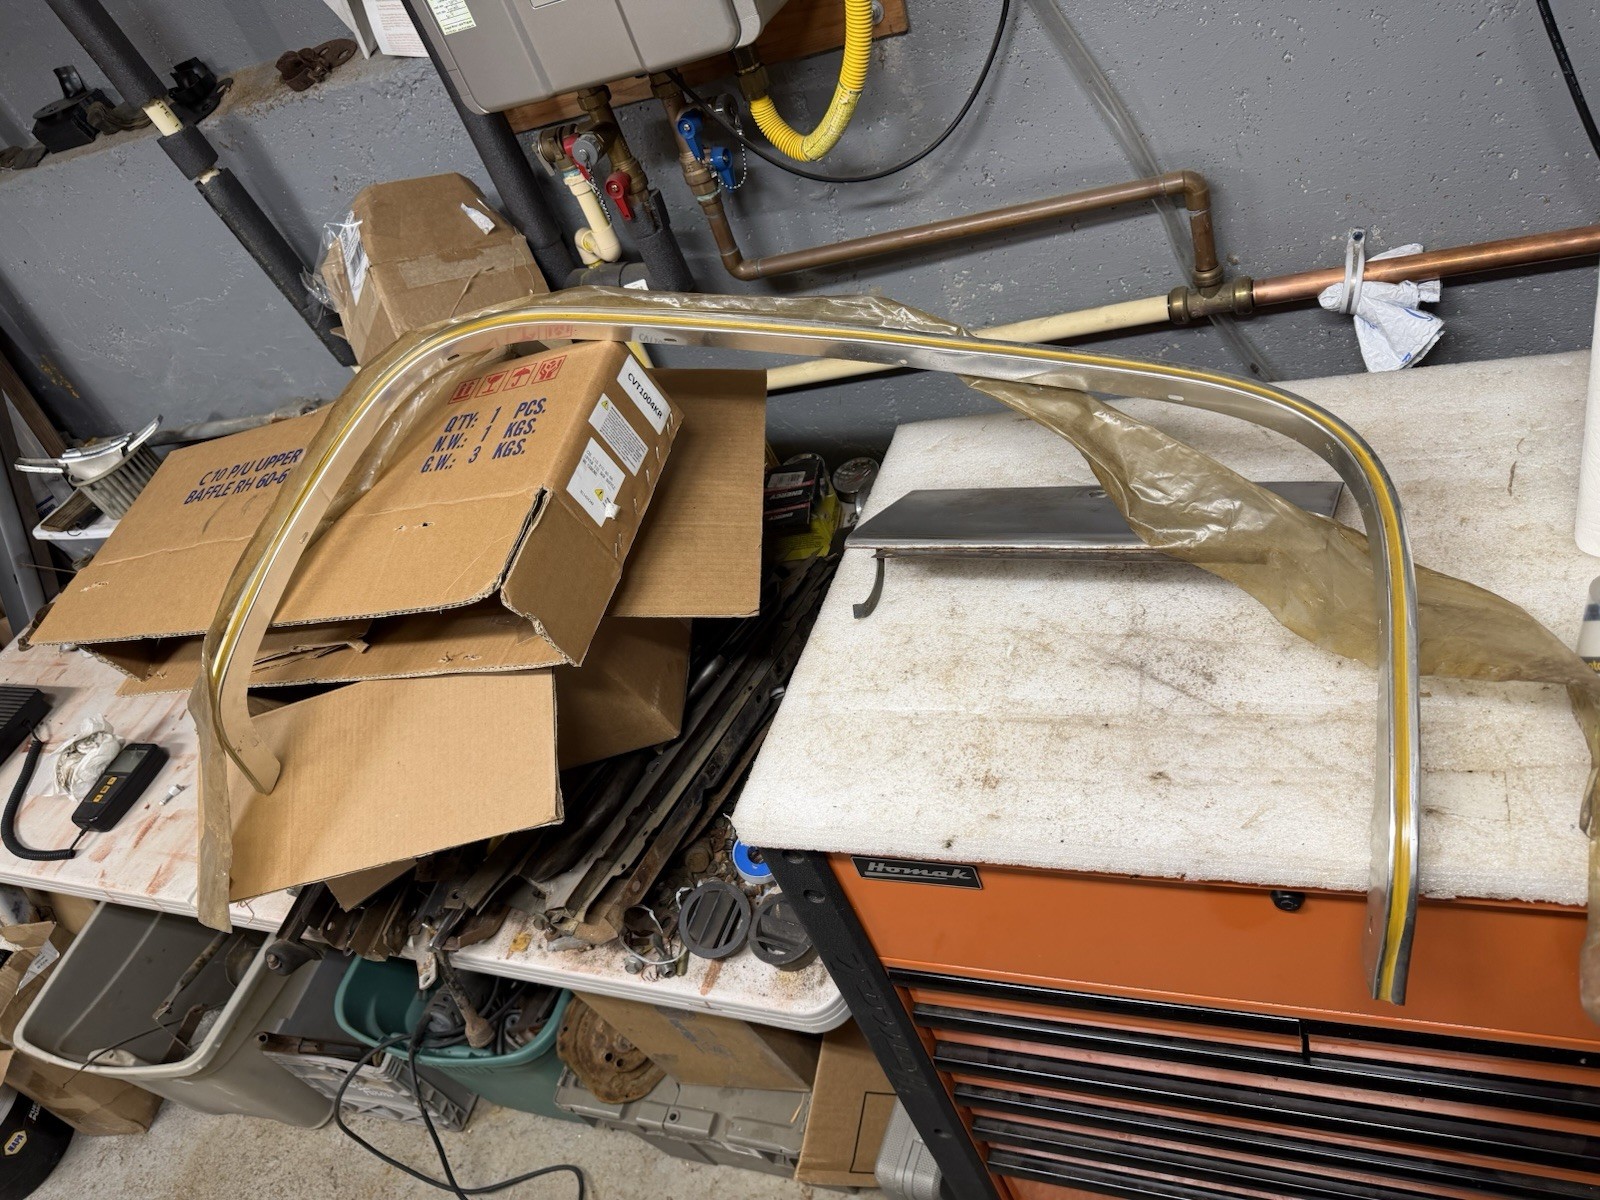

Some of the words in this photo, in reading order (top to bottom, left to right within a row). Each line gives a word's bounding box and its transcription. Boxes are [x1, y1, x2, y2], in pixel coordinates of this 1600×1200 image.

[628, 373, 663, 419] CVT1004KR
[444, 412, 479, 432] Q'TY:
[490, 406, 501, 423] 1
[514, 398, 546, 419] PCS.
[432, 433, 467, 453] N.W.:
[481, 425, 491, 442] 1
[503, 418, 536, 438] KGS.
[226, 461, 255, 480] P/U
[255, 449, 303, 472] UPPER
[421, 454, 456, 473] G.W.:
[468, 446, 481, 463] 3
[492, 438, 526, 459] KGS.
[184, 482, 235, 505] BAFFLE
[232, 477, 257, 495] RH
[255, 468, 291, 489] 60-6
[864, 862, 972, 880] Homak
[8, 1134, 24, 1152] NAPA
